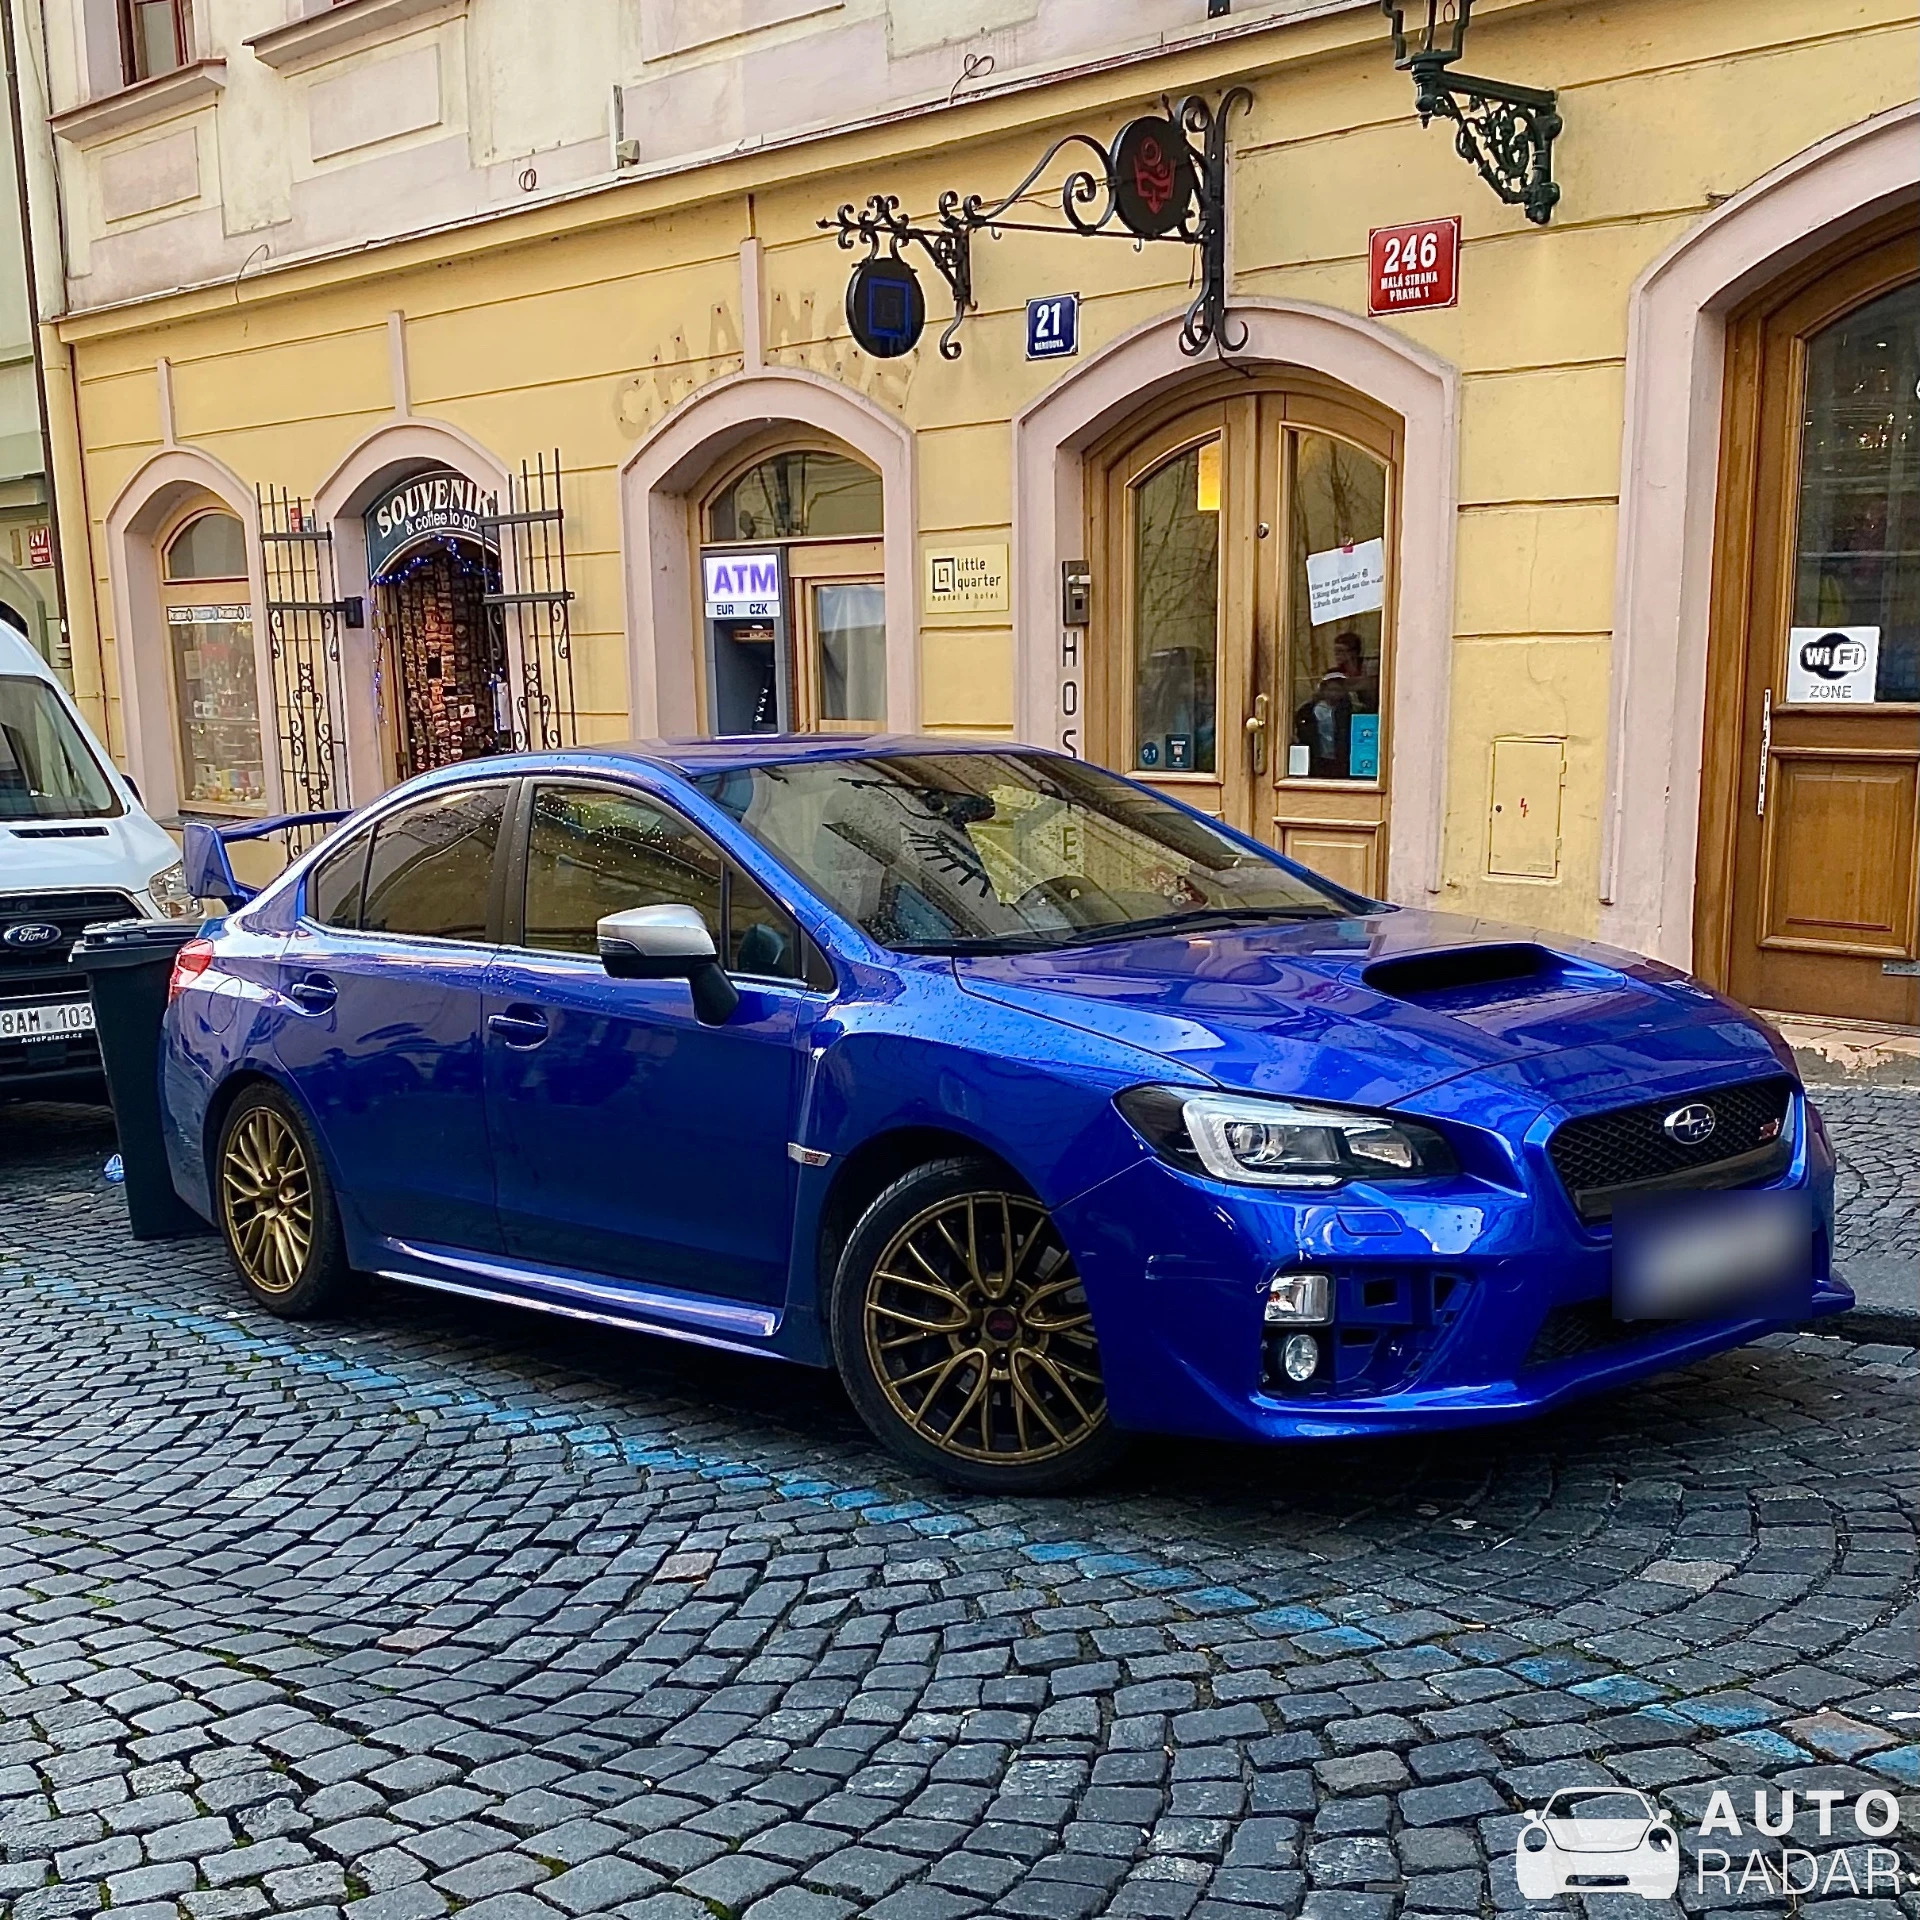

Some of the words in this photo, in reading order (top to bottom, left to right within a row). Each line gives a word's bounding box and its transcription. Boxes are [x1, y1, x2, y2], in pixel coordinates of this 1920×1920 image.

[1383, 232, 1438, 274] 246
[1381, 273, 1404, 290] MALÁ
[1405, 271, 1438, 286] STRANA
[1389, 287, 1422, 302] PRAHA
[1423, 285, 1430, 298] 1
[1036, 302, 1061, 338] 21
[405, 519, 415, 536] &
[415, 510, 448, 531] coffee
[449, 509, 461, 526] to
[462, 515, 477, 532] go
[957, 557, 986, 572] little
[713, 563, 776, 594] ATM
[957, 574, 1002, 592] quarter
[716, 604, 734, 616] EUR
[749, 603, 769, 615] CZK
[1809, 685, 1852, 699] ZONE
[1143, 748, 1156, 759] 9,1
[19, 927, 49, 942] Ford
[2, 1010, 41, 1034] 8AM
[57, 1006, 93, 1029] 103
